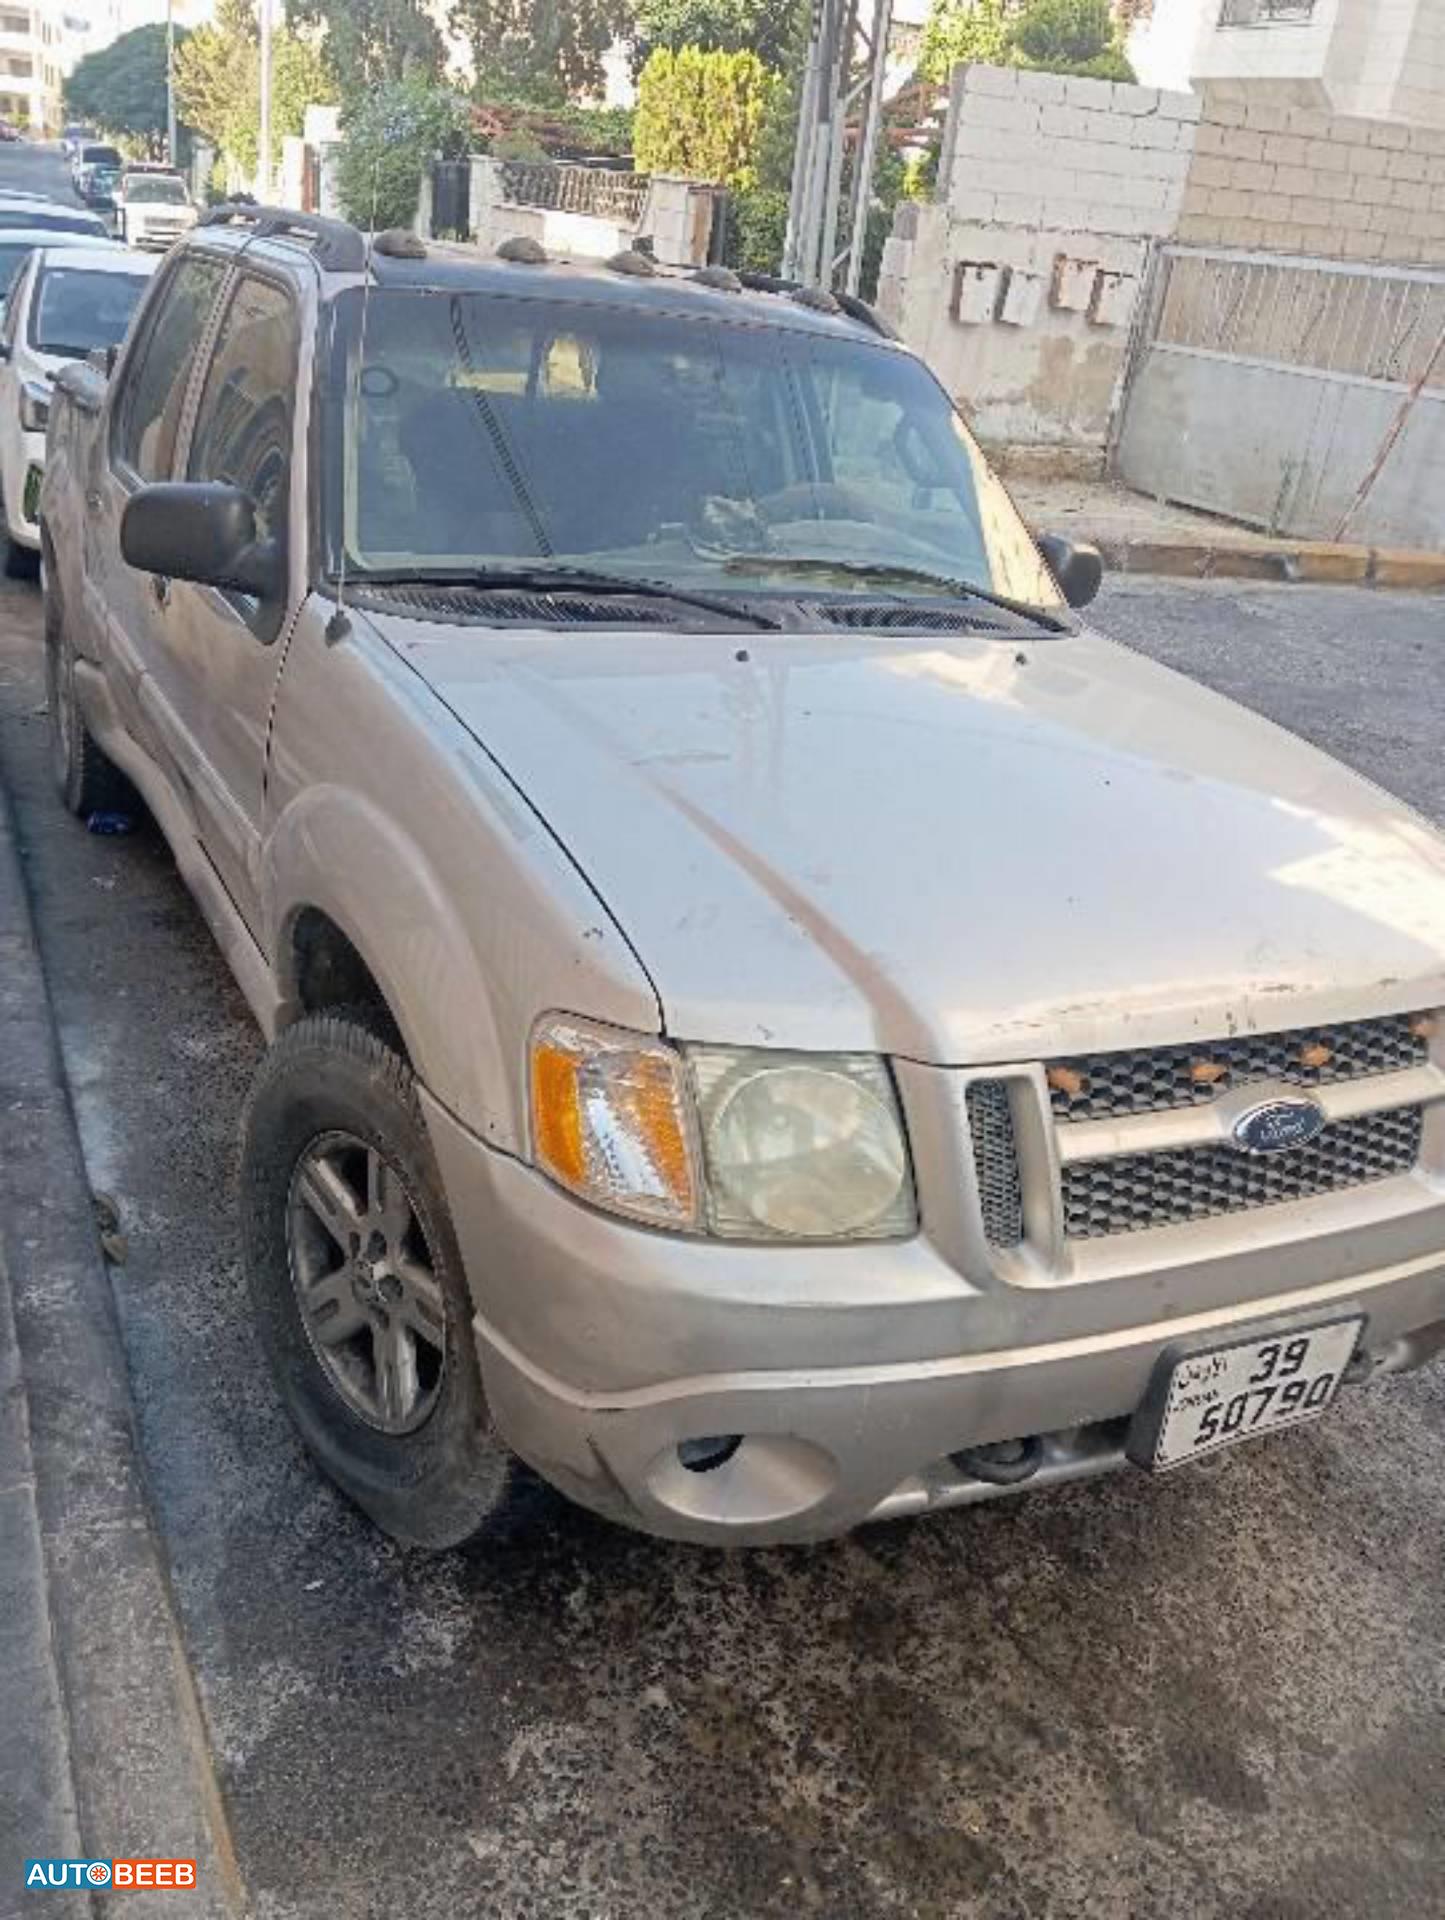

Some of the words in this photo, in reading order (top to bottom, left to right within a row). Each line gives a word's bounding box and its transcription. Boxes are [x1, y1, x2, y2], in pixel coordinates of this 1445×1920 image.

[1260, 1112, 1305, 1141] Ford
[1250, 1338, 1309, 1384] 39
[1194, 1373, 1334, 1445] 50790
